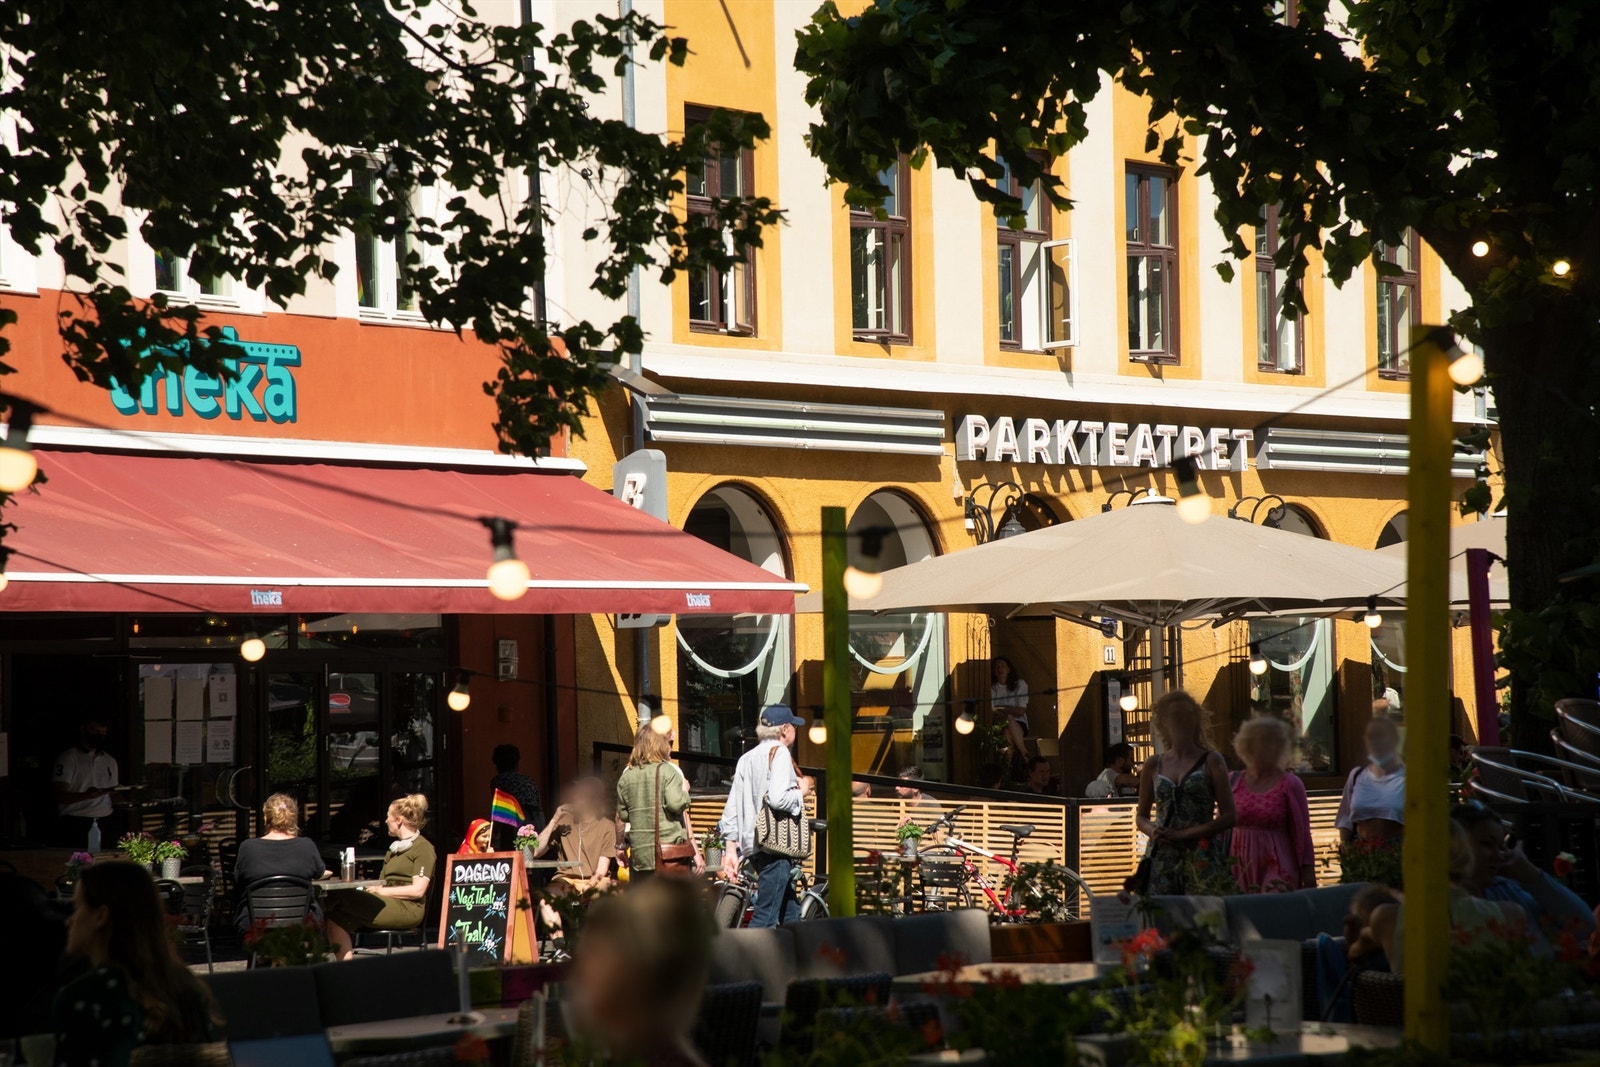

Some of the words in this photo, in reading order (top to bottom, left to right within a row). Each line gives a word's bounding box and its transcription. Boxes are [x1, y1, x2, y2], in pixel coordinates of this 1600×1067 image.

[956, 414, 1254, 472] PARKTEATRET
[1106, 648, 1115, 661] 11
[56, 764, 64, 777] 3
[454, 861, 510, 883] DAGENS
[471, 884, 497, 905] Thali
[455, 919, 489, 943] Thali
